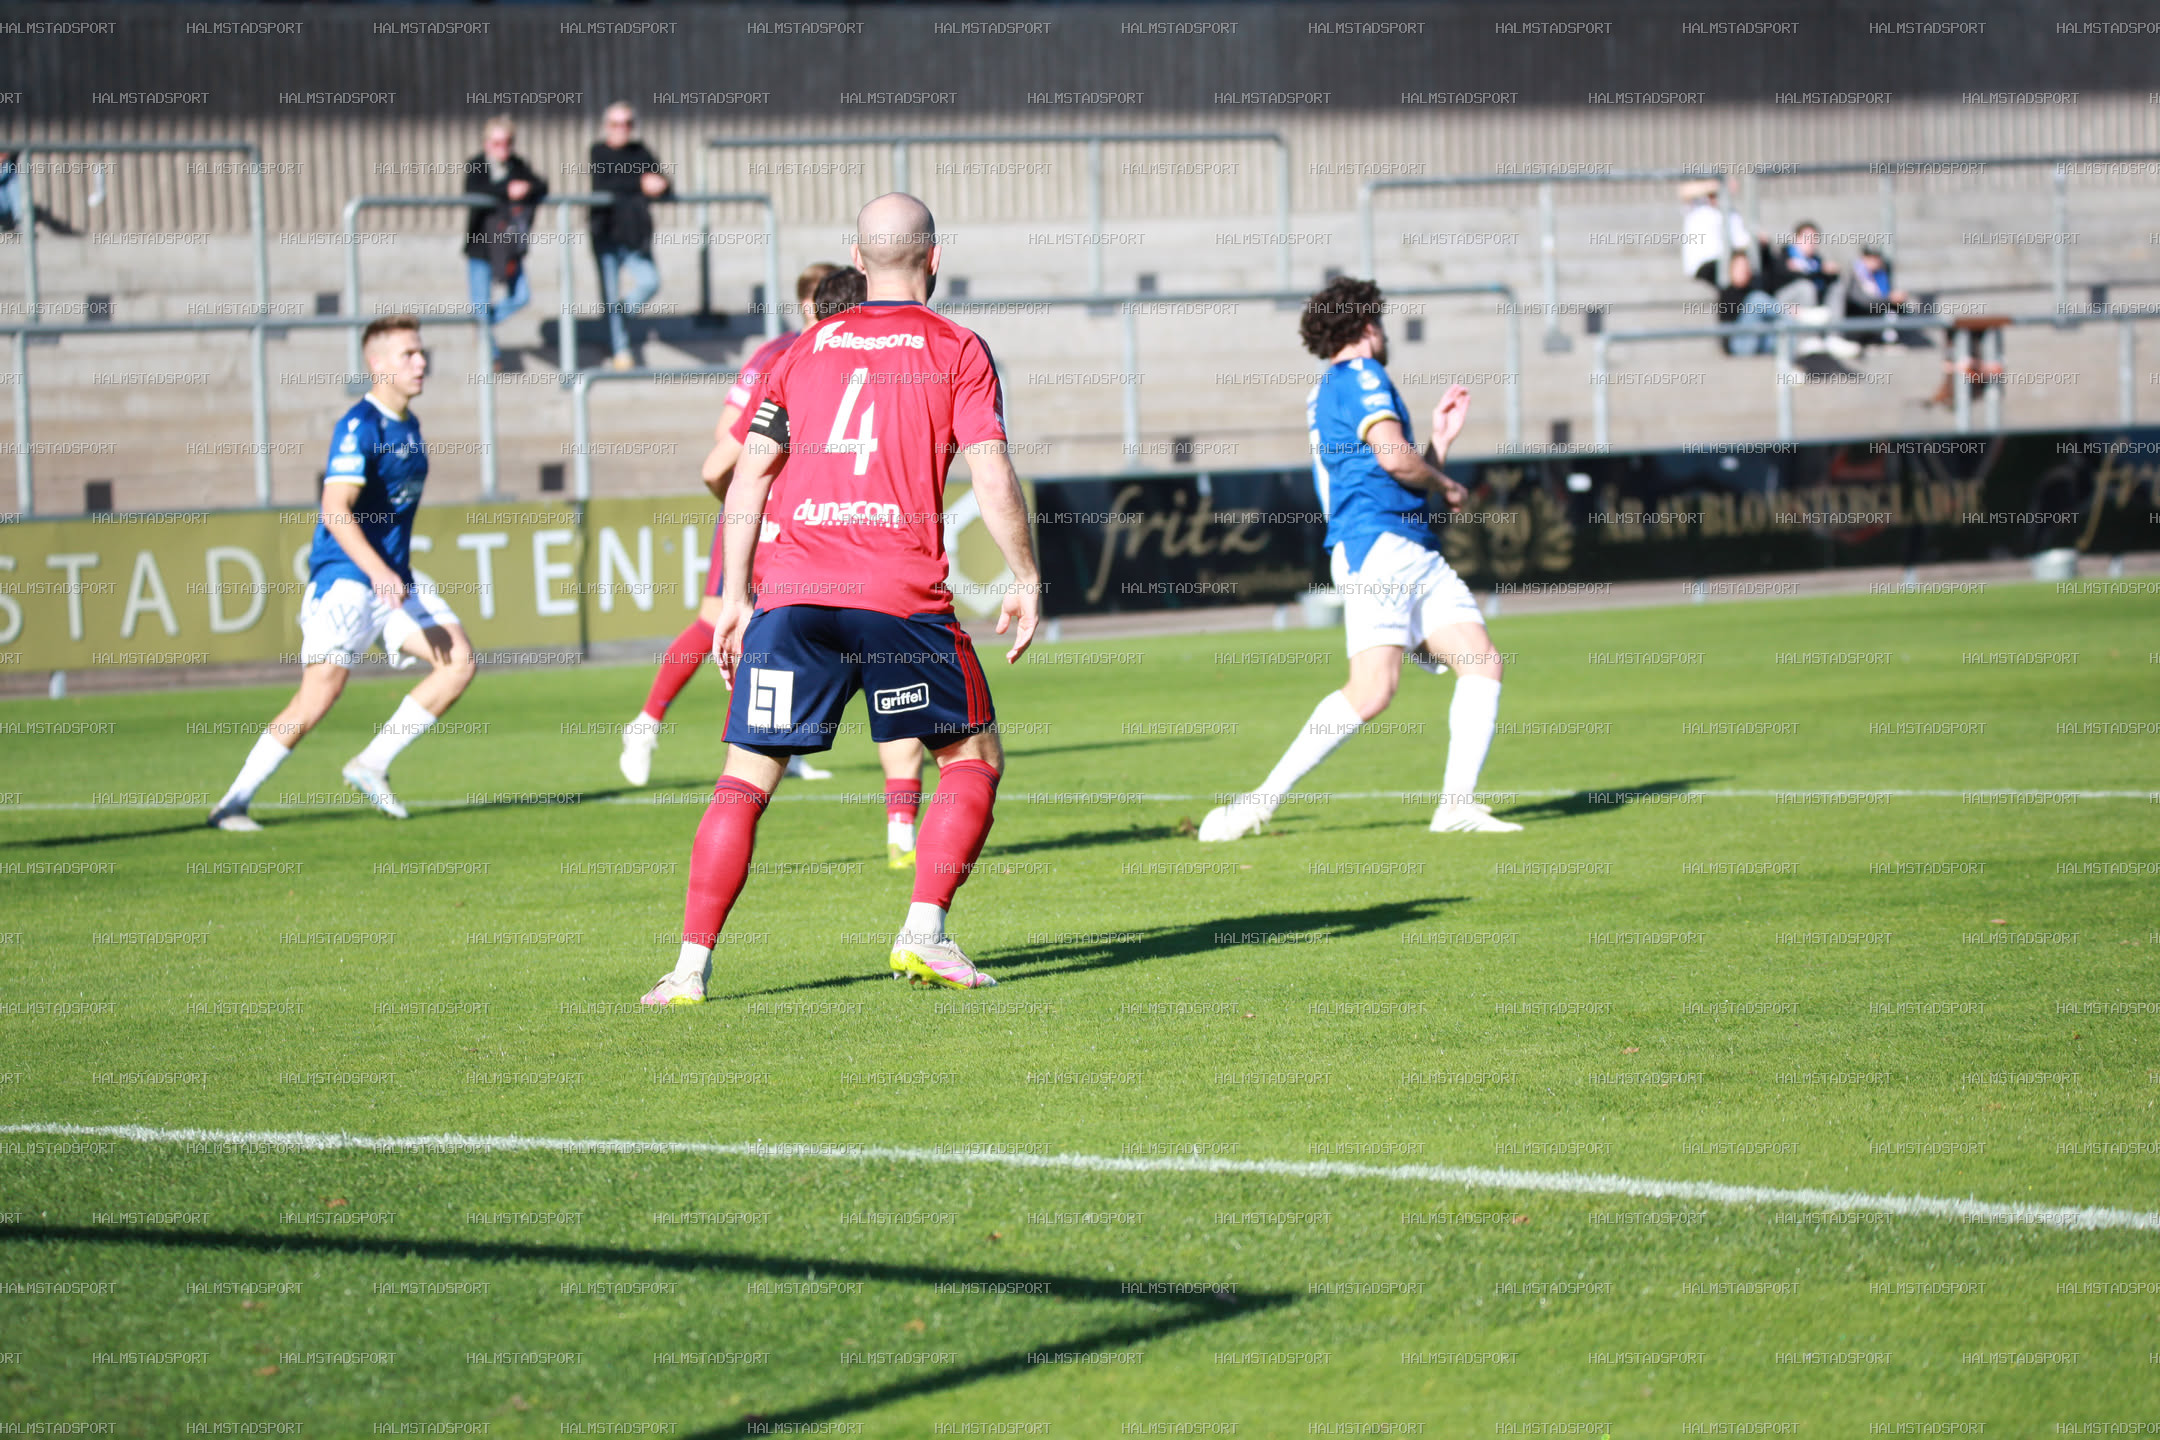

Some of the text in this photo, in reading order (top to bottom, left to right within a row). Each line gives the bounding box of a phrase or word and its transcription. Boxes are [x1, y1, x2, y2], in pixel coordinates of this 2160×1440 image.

[813, 321, 925, 354] Fellessons
[825, 367, 878, 475] 4
[793, 498, 900, 526] dynacon
[1085, 483, 1270, 603] fritz
[881, 688, 922, 710] griffel
